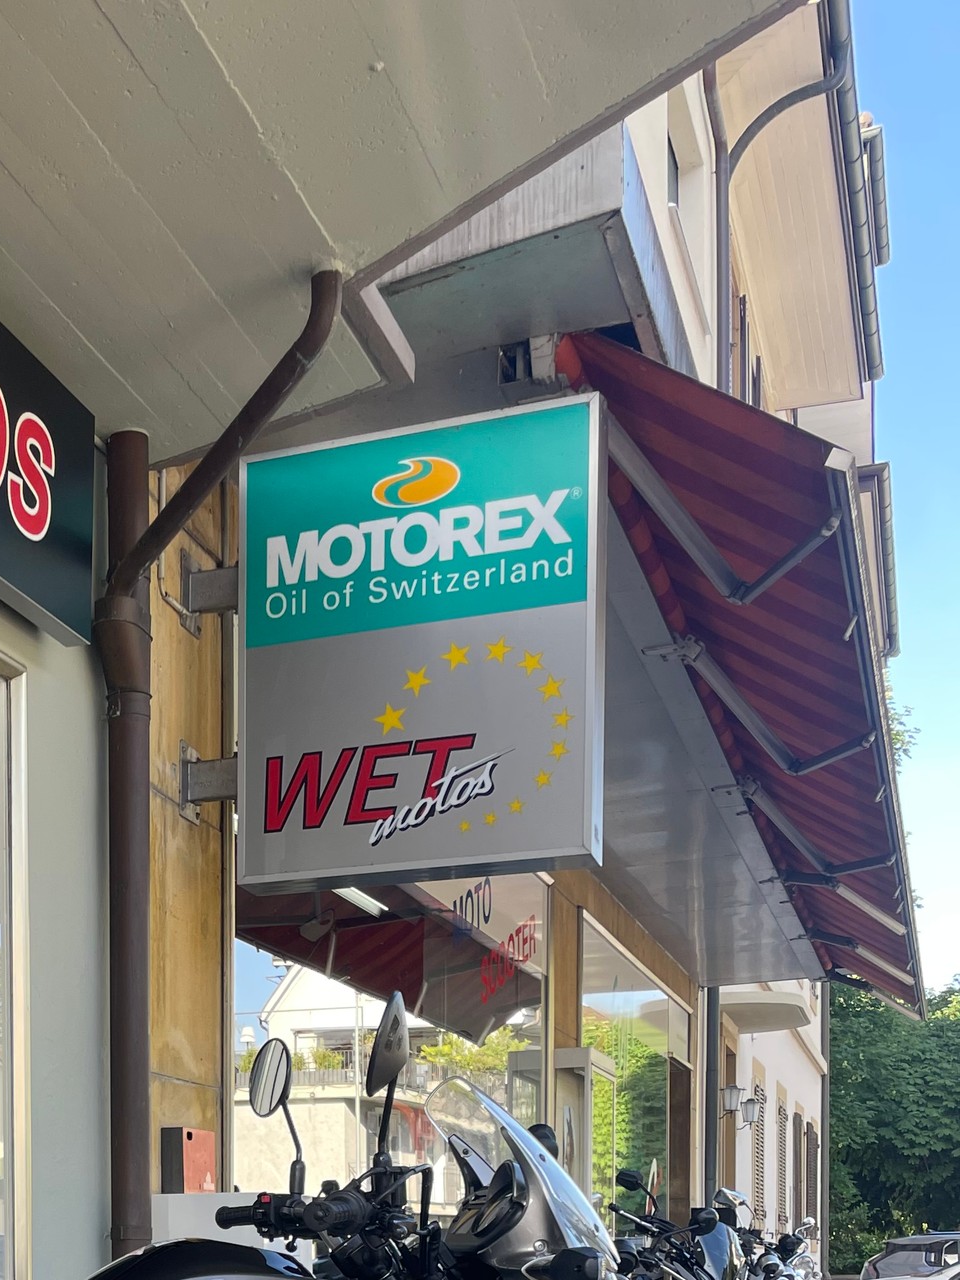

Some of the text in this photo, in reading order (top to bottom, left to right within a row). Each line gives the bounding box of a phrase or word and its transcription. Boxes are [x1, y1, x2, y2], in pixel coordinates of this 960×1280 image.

[265, 549, 573, 619] Oil of Switzerland
[266, 488, 573, 588] MOTOREX
[264, 733, 477, 834] WET
[368, 749, 514, 846] motos
[452, 876, 492, 945] MOTO
[481, 914, 537, 1006] SCOOTER
